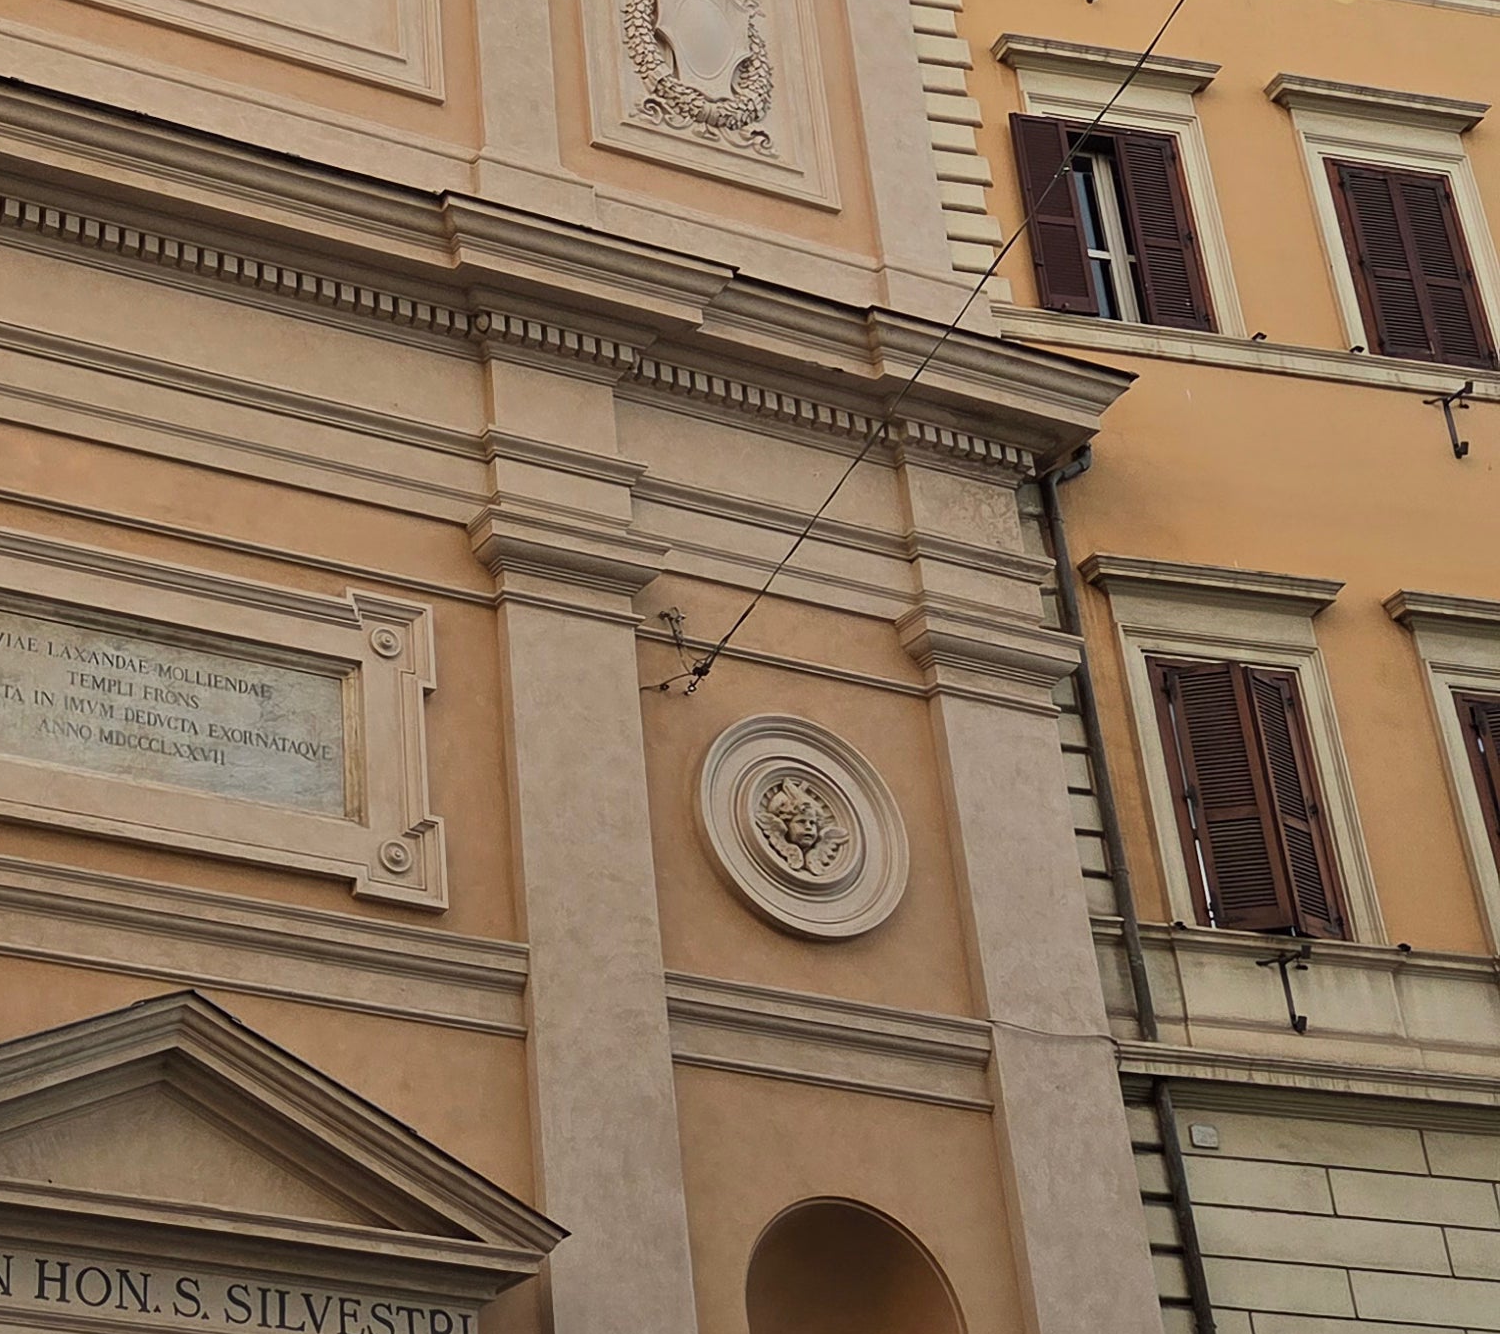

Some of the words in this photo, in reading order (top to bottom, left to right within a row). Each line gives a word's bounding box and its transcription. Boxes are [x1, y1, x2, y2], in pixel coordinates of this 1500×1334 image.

[47, 641, 149, 675] LAXANDAE
[157, 664, 274, 699] MOLLIENDAE
[67, 670, 134, 697] TEMPLI
[143, 686, 200, 710] FRONS
[34, 690, 55, 707] IN
[64, 695, 114, 719] IMVM
[124, 707, 199, 735] DEDVCTA
[208, 723, 333, 762] EXORNATAQVE
[38, 718, 92, 741] ANNO
[34, 1258, 161, 1314] HON.
[173, 1277, 210, 1320] S.
